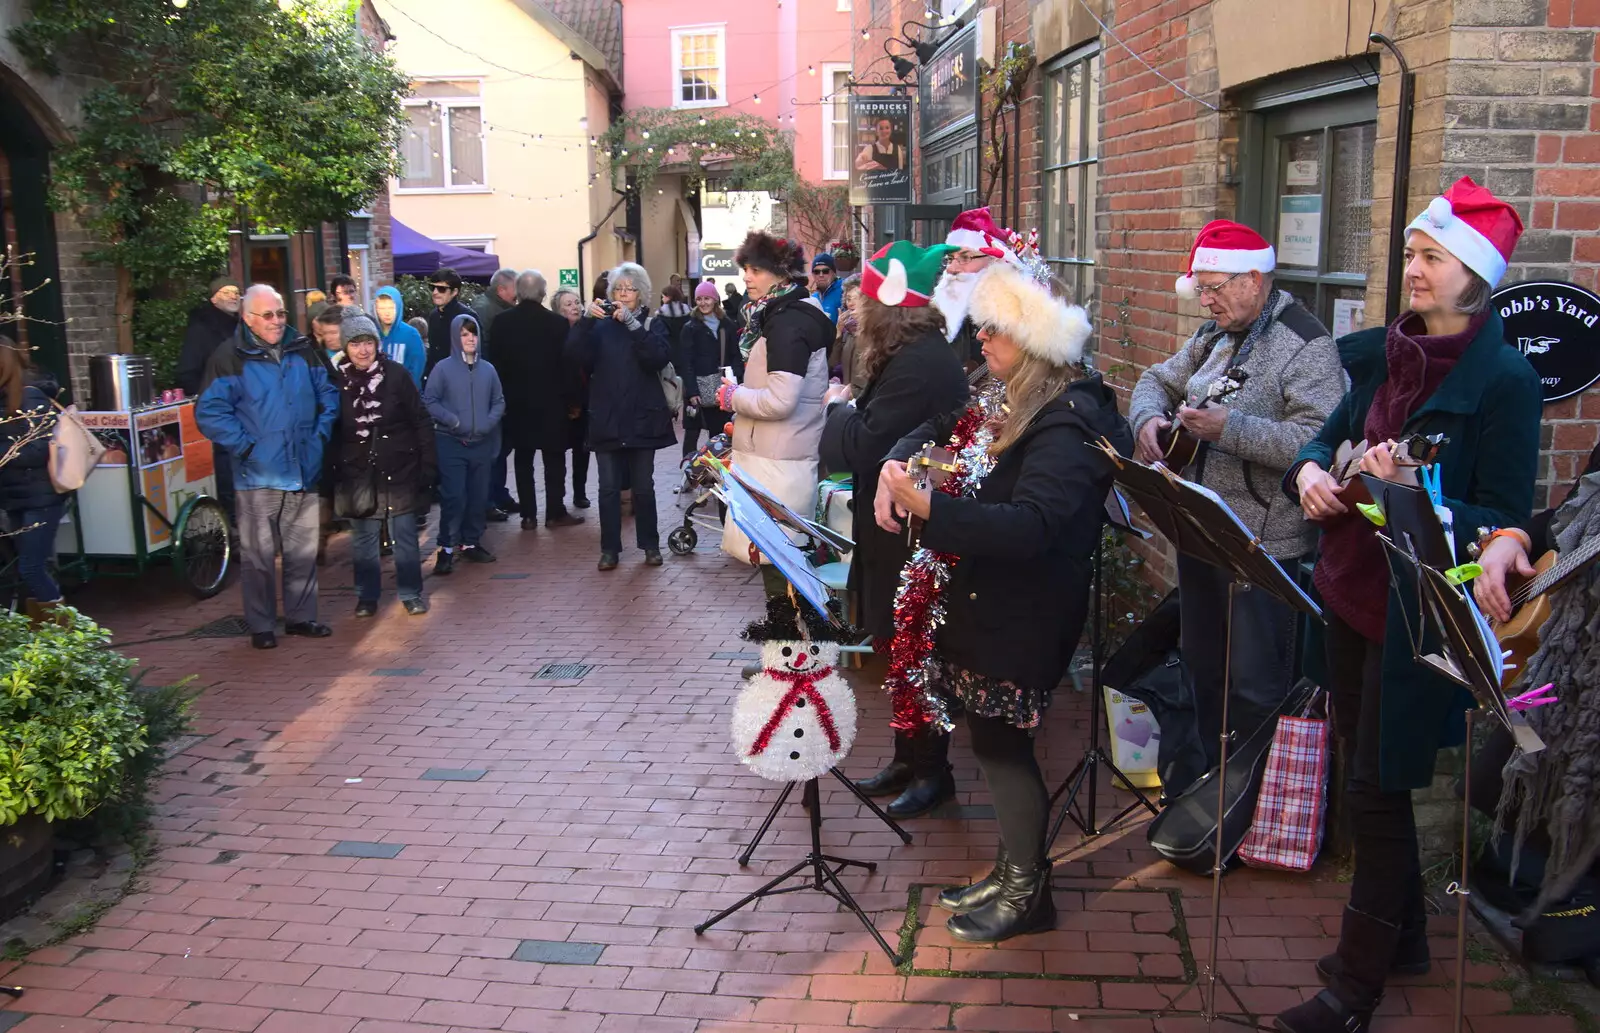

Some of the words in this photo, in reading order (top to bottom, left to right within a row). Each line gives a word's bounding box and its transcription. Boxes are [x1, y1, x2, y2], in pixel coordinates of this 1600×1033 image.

[1284, 235, 1312, 244] ENTRANCE
[702, 254, 732, 271] CHAPS
[1500, 295, 1550, 318] obb's
[1555, 296, 1599, 328] Yard
[101, 415, 129, 426] Cider
